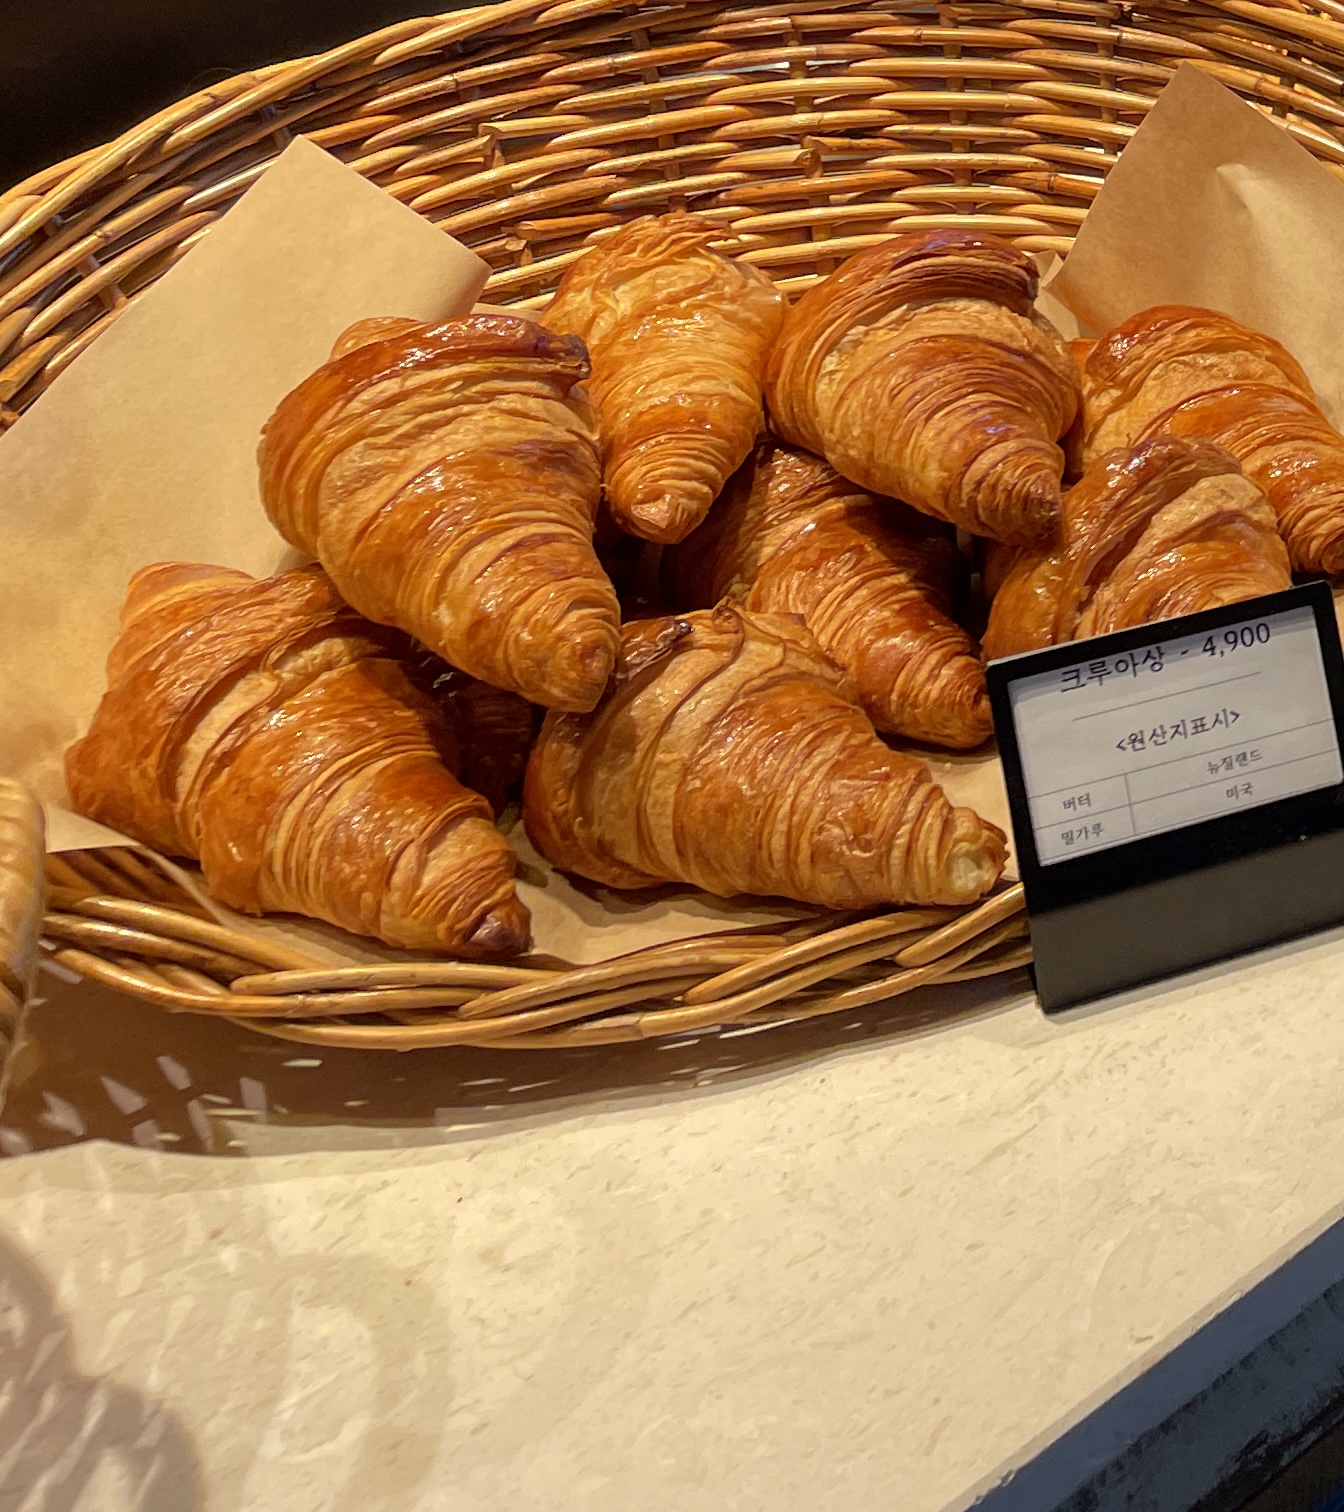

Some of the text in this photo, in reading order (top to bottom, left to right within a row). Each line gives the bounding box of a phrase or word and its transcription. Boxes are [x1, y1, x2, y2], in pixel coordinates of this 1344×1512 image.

[1059, 644, 1167, 694] 크루아상
[1201, 621, 1272, 659] 4,900
[1115, 707, 1242, 752] <원산지표시>
[1206, 747, 1264, 776] 뉴질랜드
[1062, 793, 1092, 813] 버터
[1225, 781, 1255, 801] 미국
[1059, 821, 1105, 847] 밀가루
